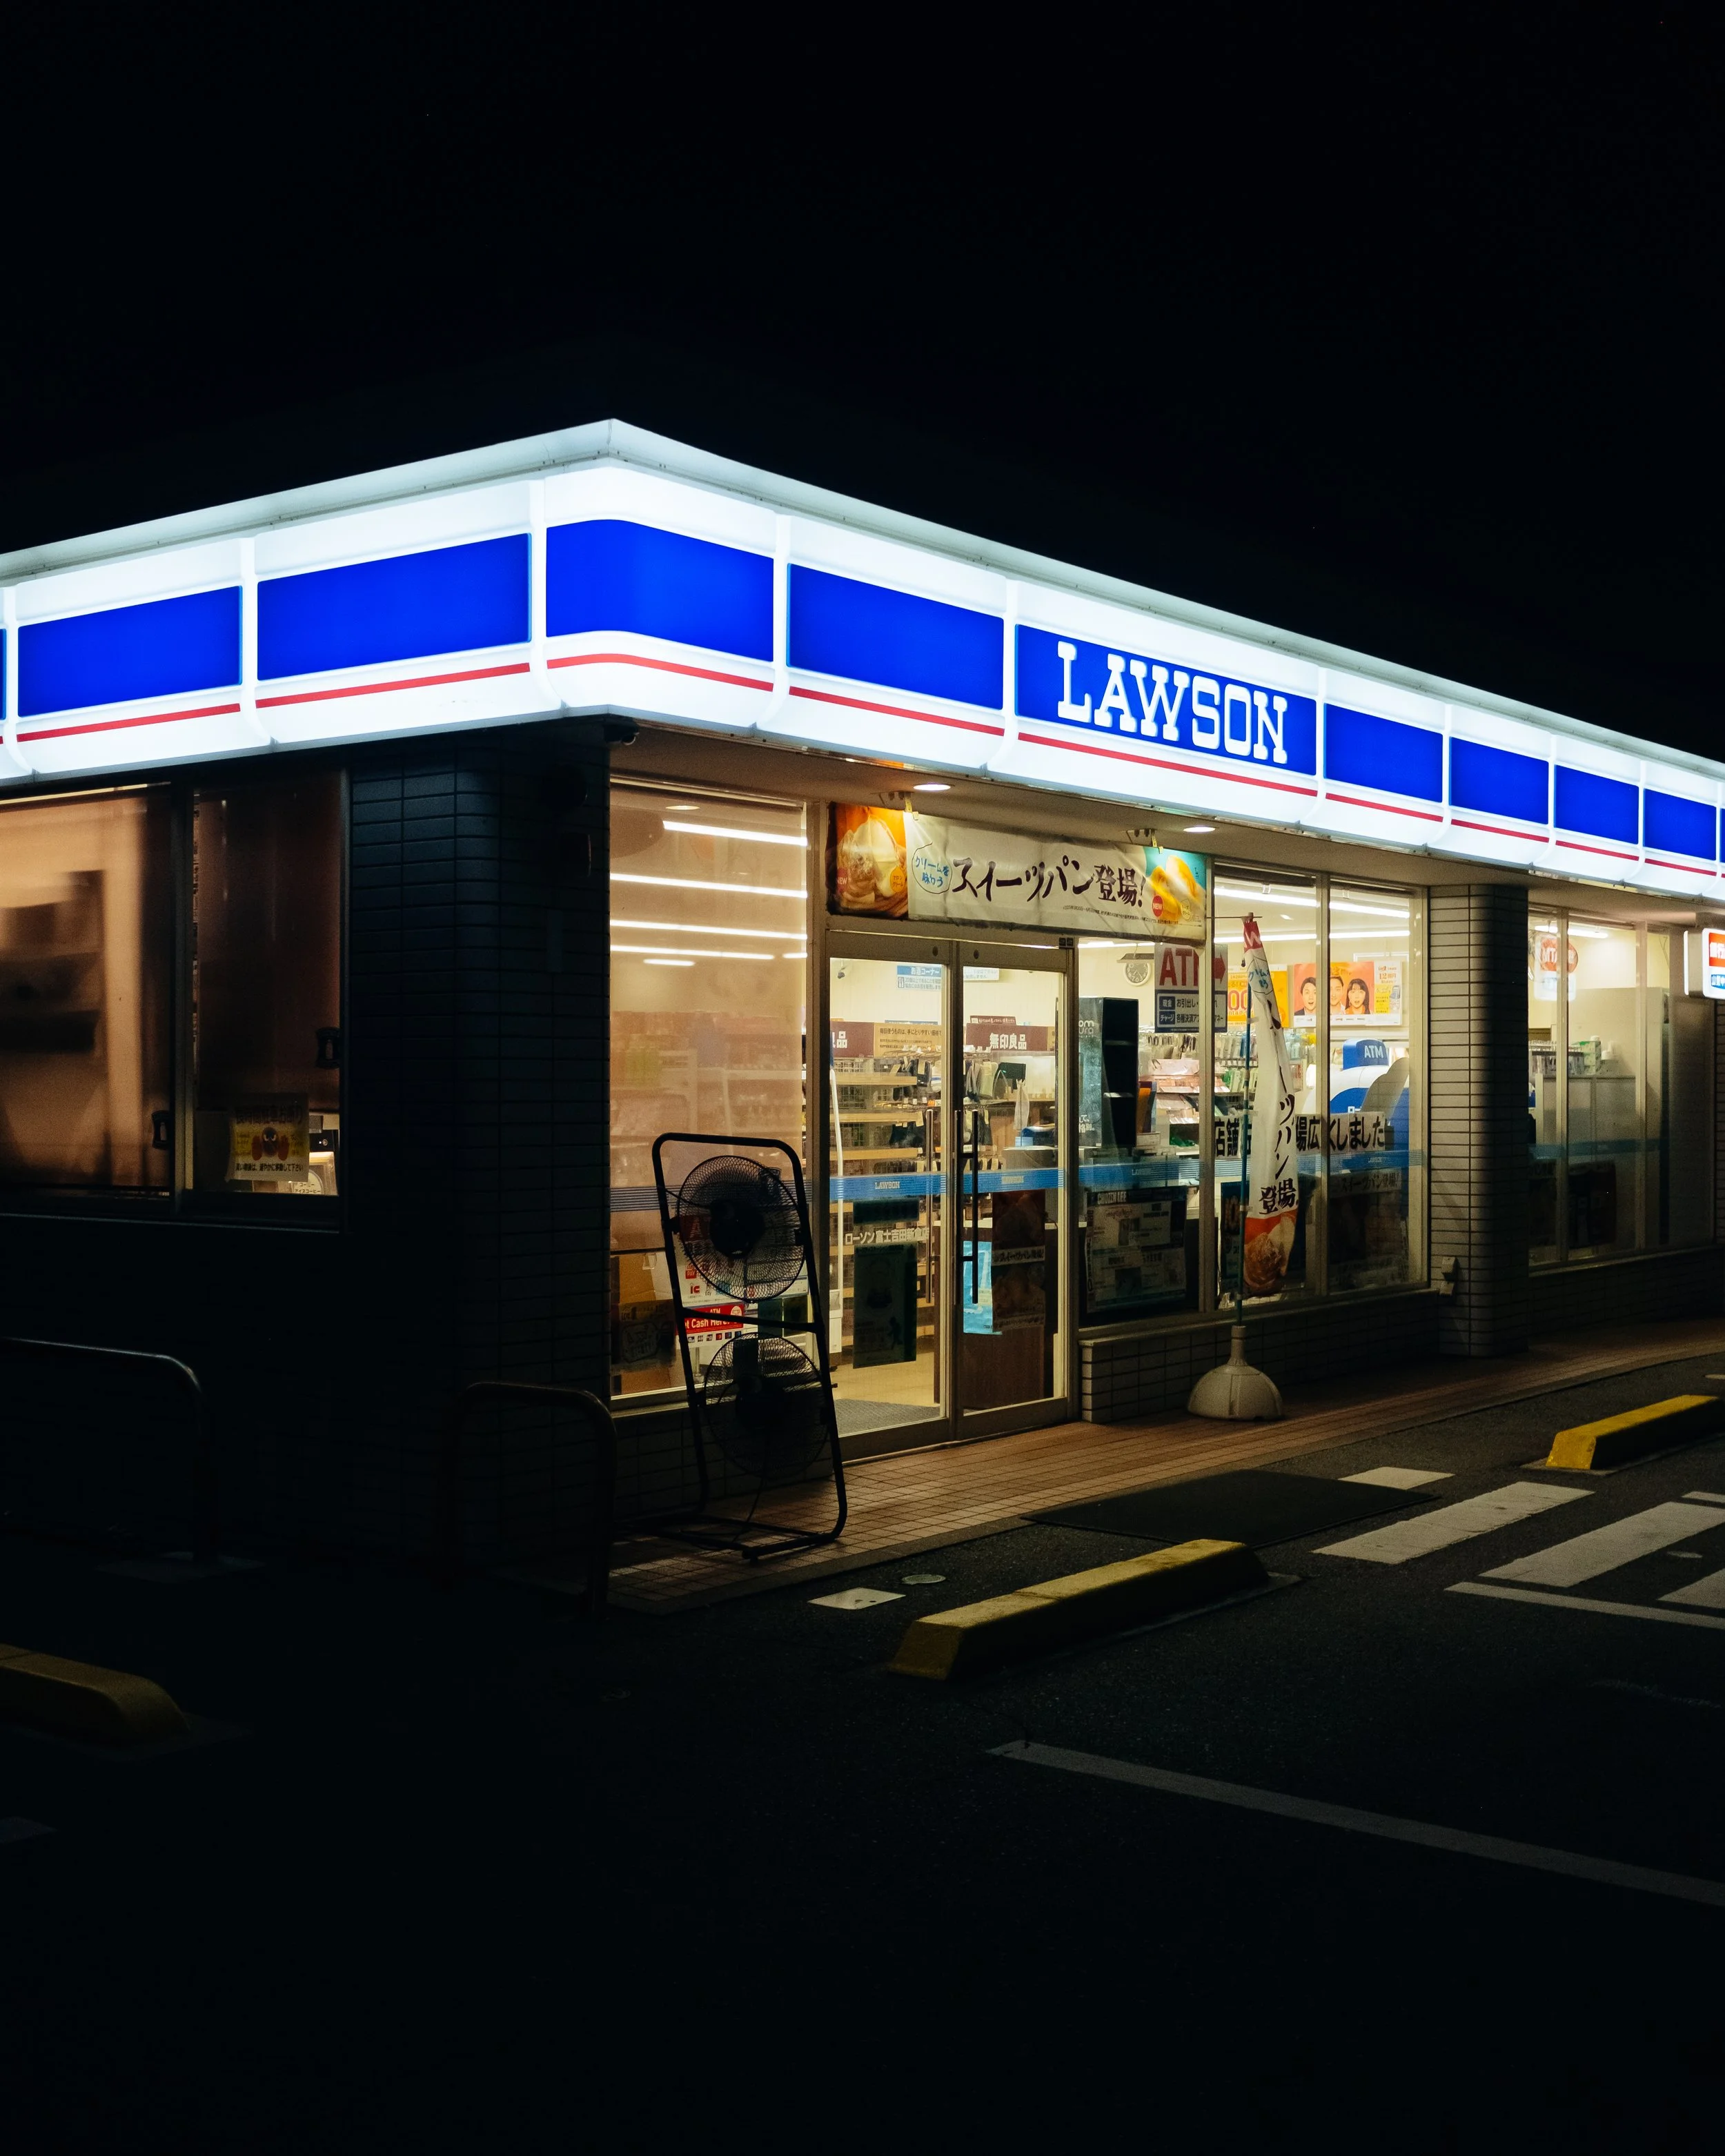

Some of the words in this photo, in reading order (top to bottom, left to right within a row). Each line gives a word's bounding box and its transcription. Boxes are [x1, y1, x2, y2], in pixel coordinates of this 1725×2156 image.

[1058, 641, 1288, 764] LAWSON
[915, 856, 949, 877] クリームを
[921, 872, 944, 888] 味わう
[952, 855, 1146, 908] スイーツパン登場!
[989, 1032, 1027, 1050] 無印良品
[1364, 1045, 1384, 1058] ATM
[874, 1181, 900, 1190] LAWSON
[691, 1318, 709, 1328] Cash
